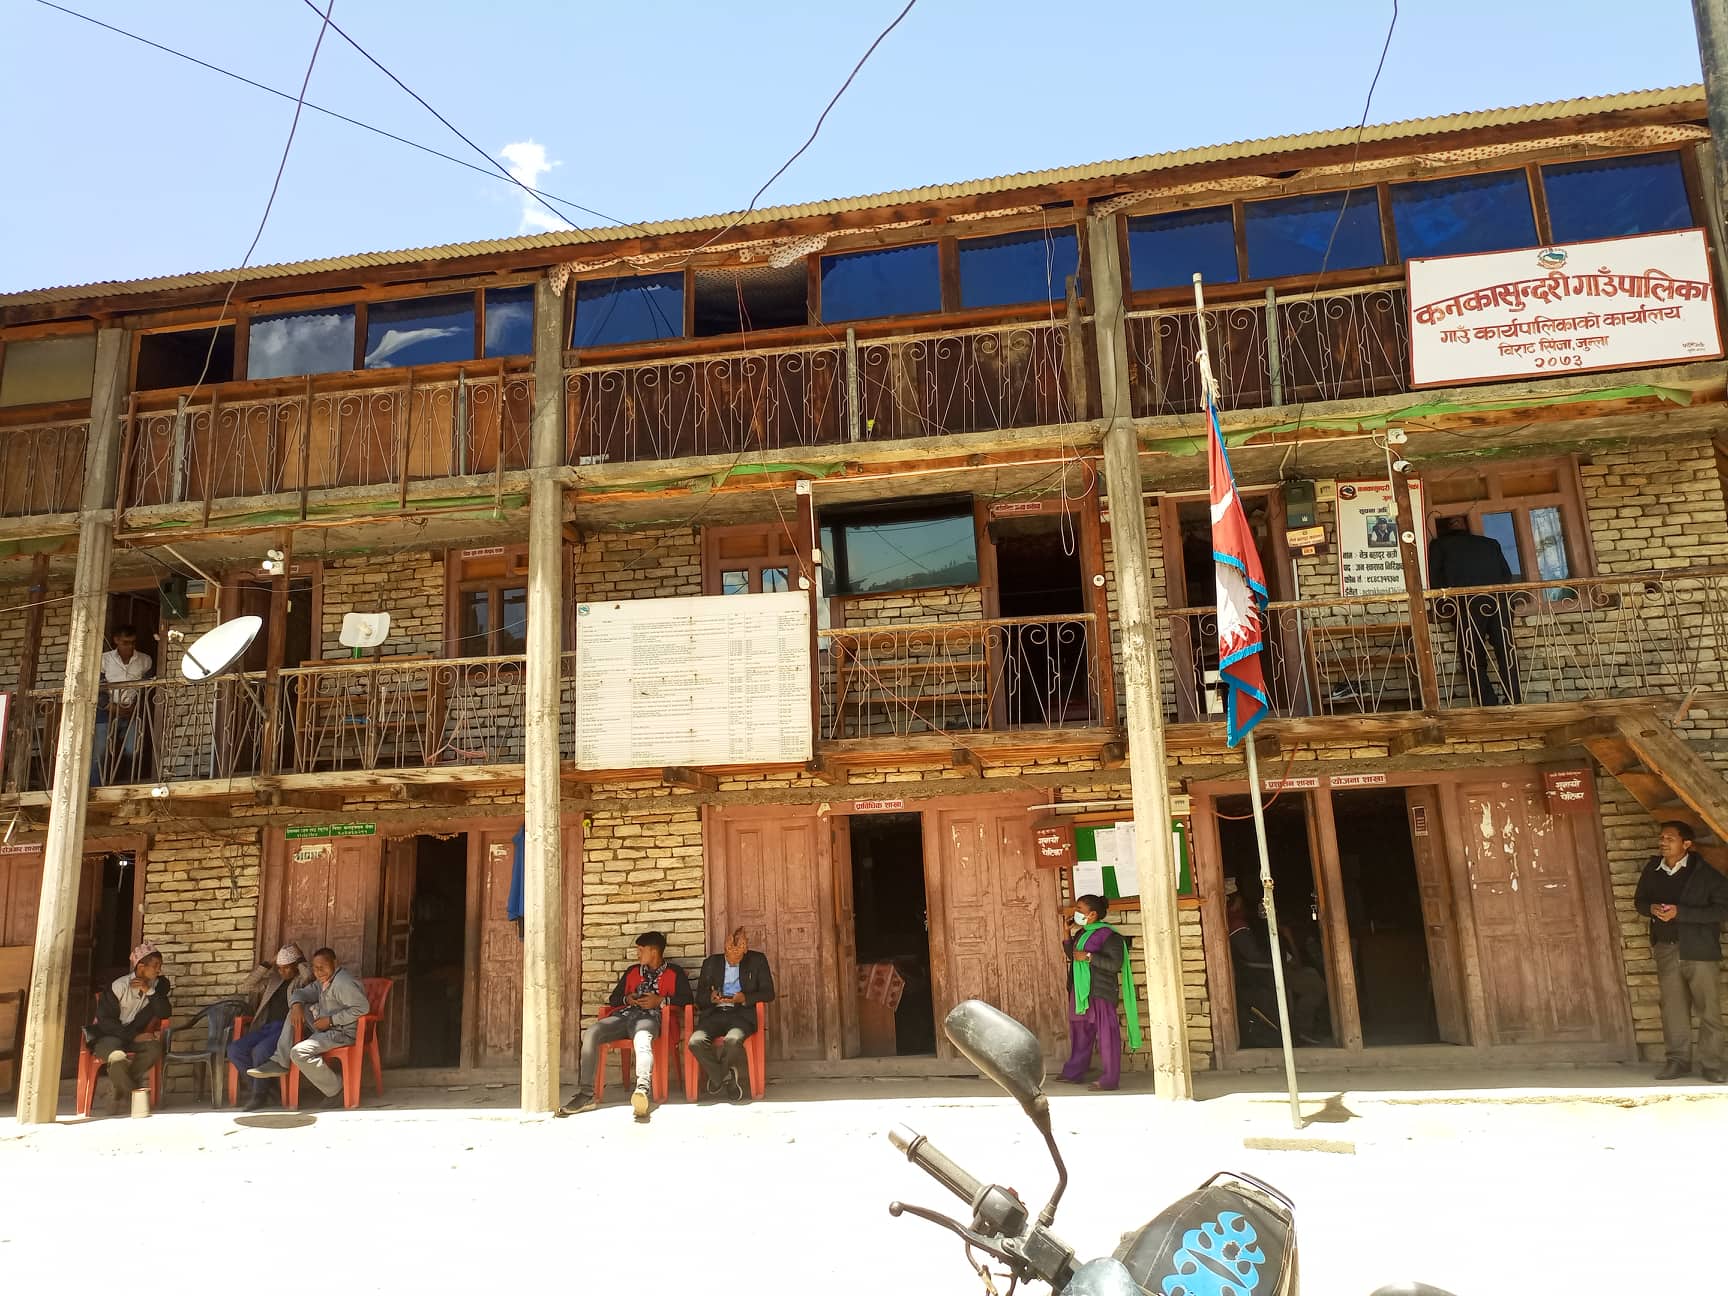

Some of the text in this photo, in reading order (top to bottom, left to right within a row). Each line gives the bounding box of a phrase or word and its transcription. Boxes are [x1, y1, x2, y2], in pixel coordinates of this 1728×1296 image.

[1413, 265, 1711, 325] कनकासुन्दरी गाउँपालिका
[1440, 303, 1683, 344] गाउँ कार्यपालिकाको कार्यालय
[1497, 342, 1536, 358] विराट
[1534, 355, 1583, 368] २०७३
